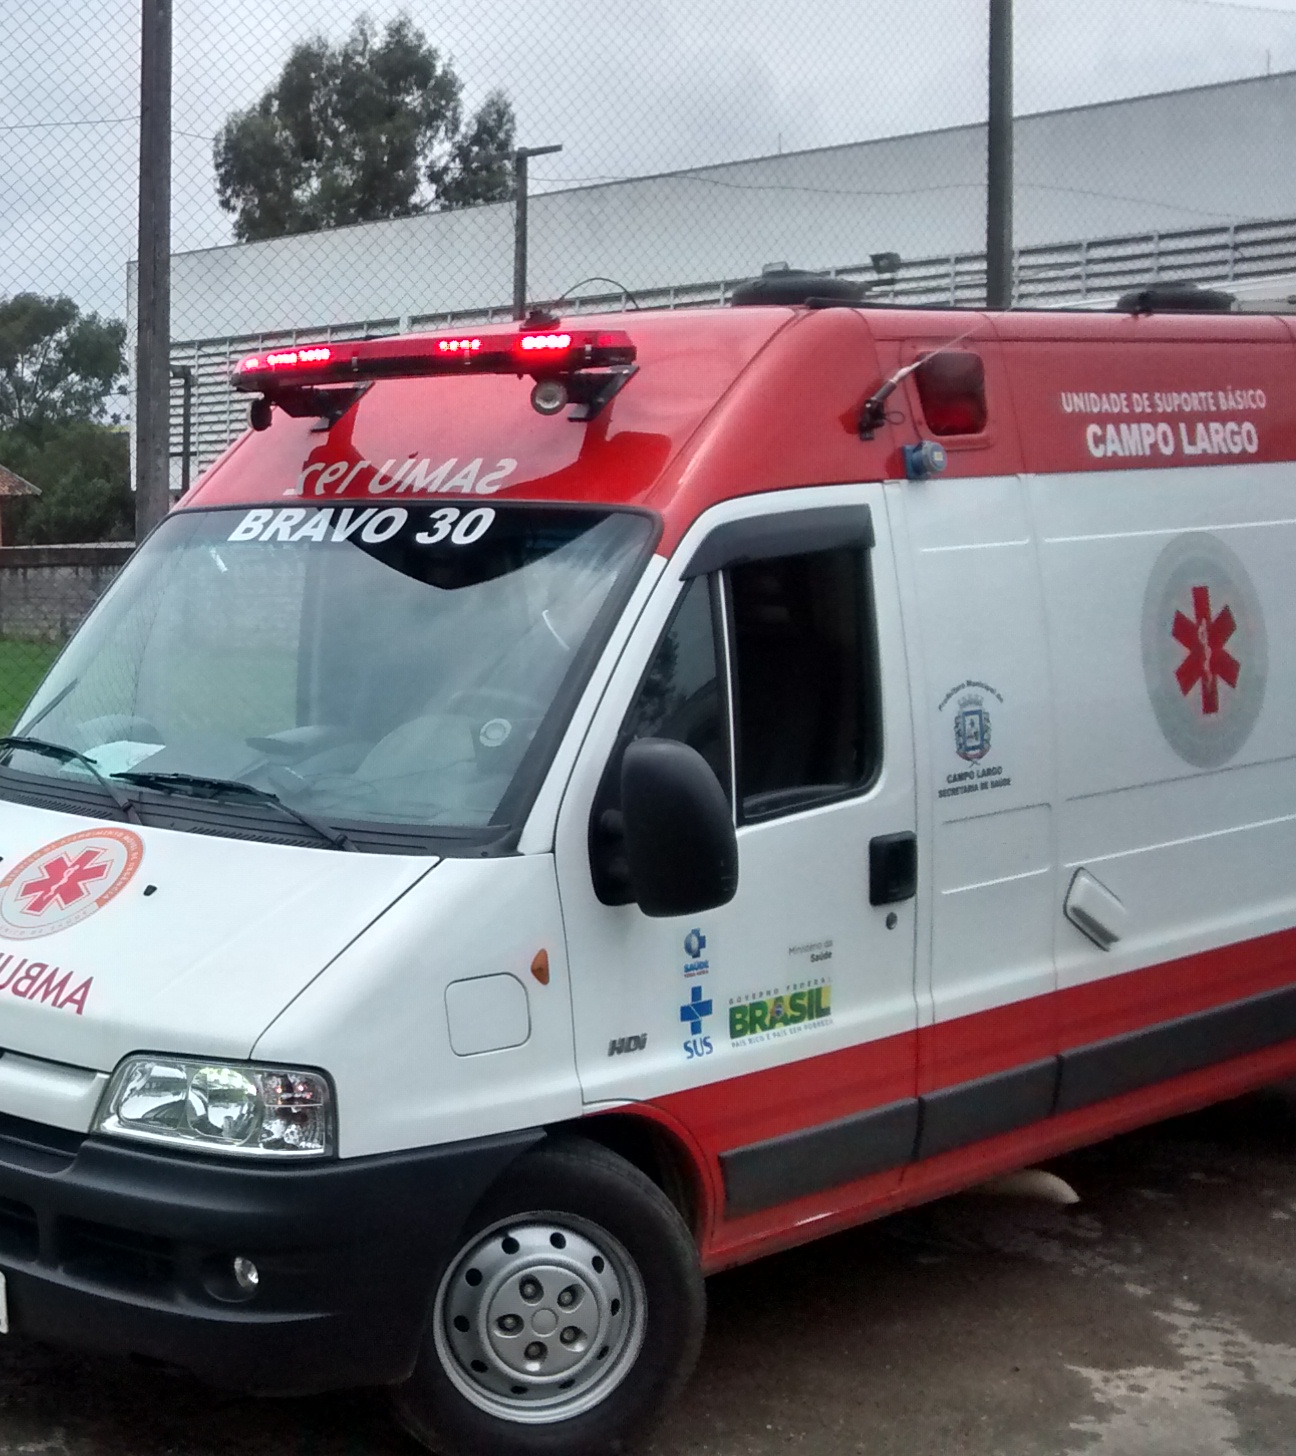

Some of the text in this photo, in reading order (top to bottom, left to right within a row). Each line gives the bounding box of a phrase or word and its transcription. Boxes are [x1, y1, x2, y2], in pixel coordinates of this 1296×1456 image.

[1060, 386, 1266, 414] UNIDADE DE SUPORTE BÁSICO
[1086, 421, 1259, 458] CAMPO LARGO
[227, 507, 496, 546] BRAVO 30
[946, 766, 1003, 784] CAMPO LARGO
[938, 784, 979, 798] SECRETARIA
[980, 781, 989, 790] DE
[810, 950, 833, 963] Saúde
[728, 976, 833, 1005] GOVERNO FEDERAL
[729, 986, 832, 1040] BRASIL
[683, 1036, 714, 1060] SUS
[748, 1037, 765, 1045] RICO
